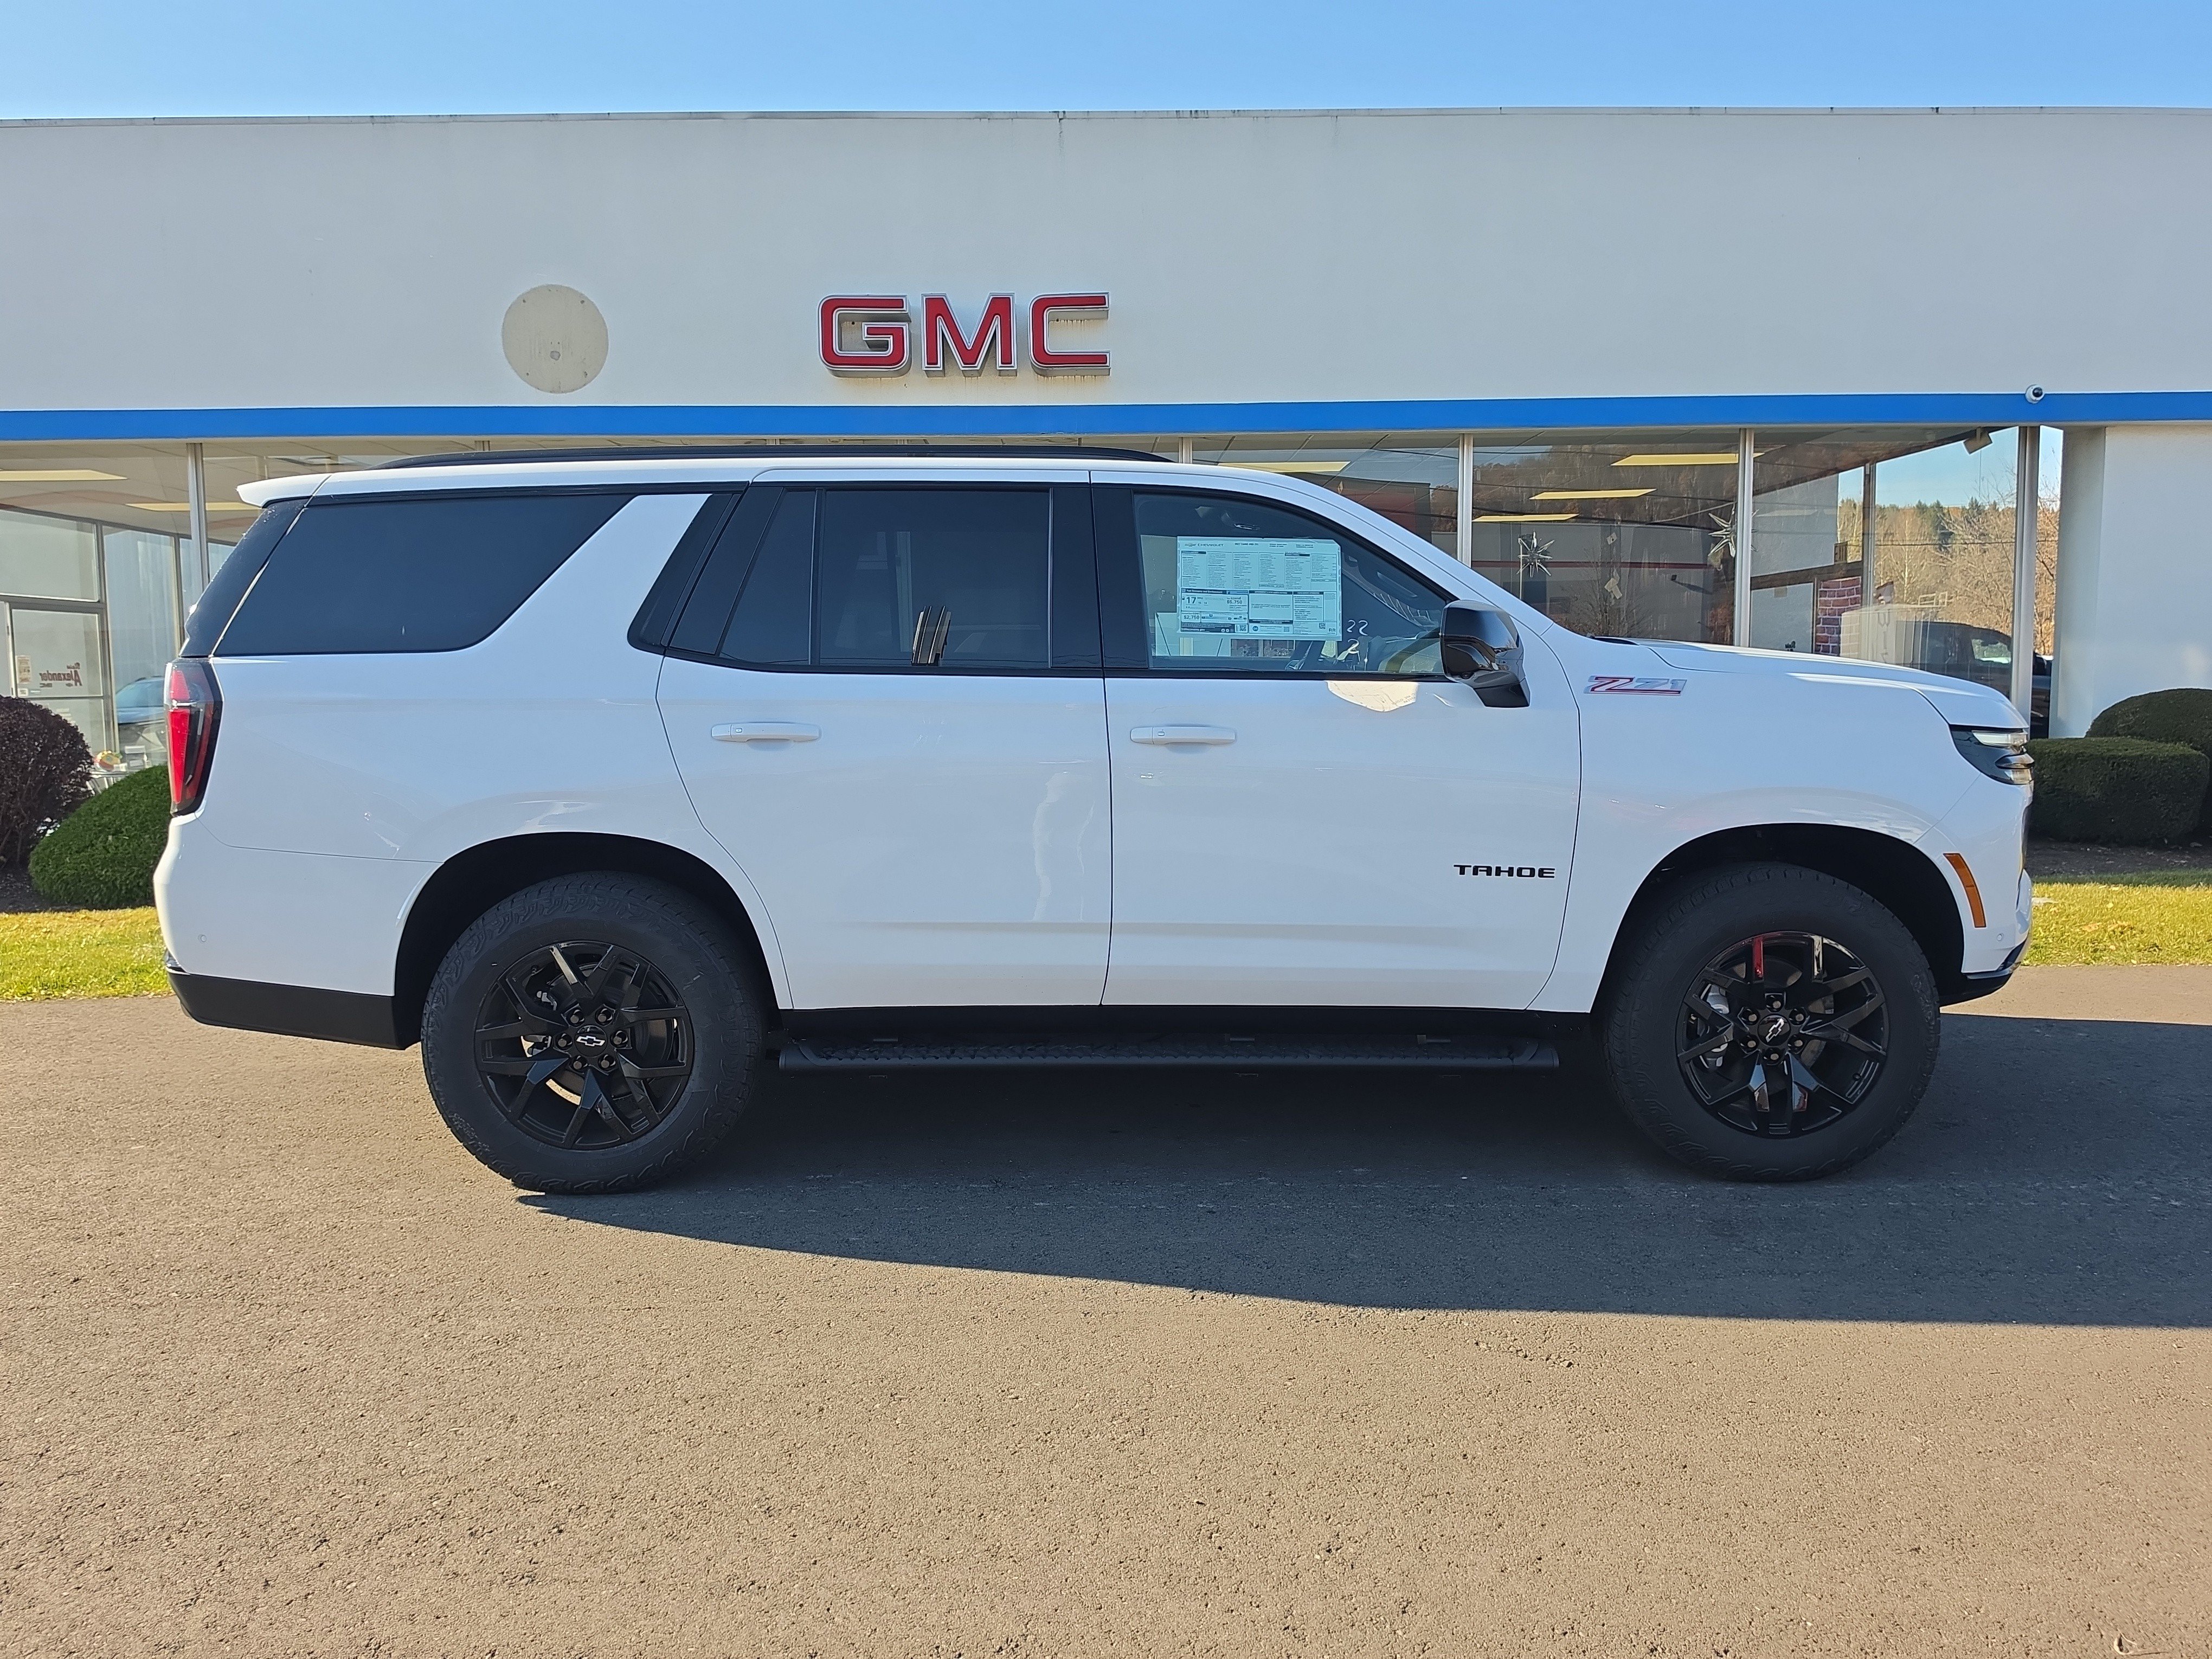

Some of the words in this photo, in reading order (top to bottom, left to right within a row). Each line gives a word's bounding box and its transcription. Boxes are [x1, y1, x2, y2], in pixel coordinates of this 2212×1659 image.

[818, 292, 1110, 376] GMC
[1347, 620, 1368, 636] 22
[1584, 676, 1687, 696] Z71
[1454, 864, 1555, 878] TAHOE
